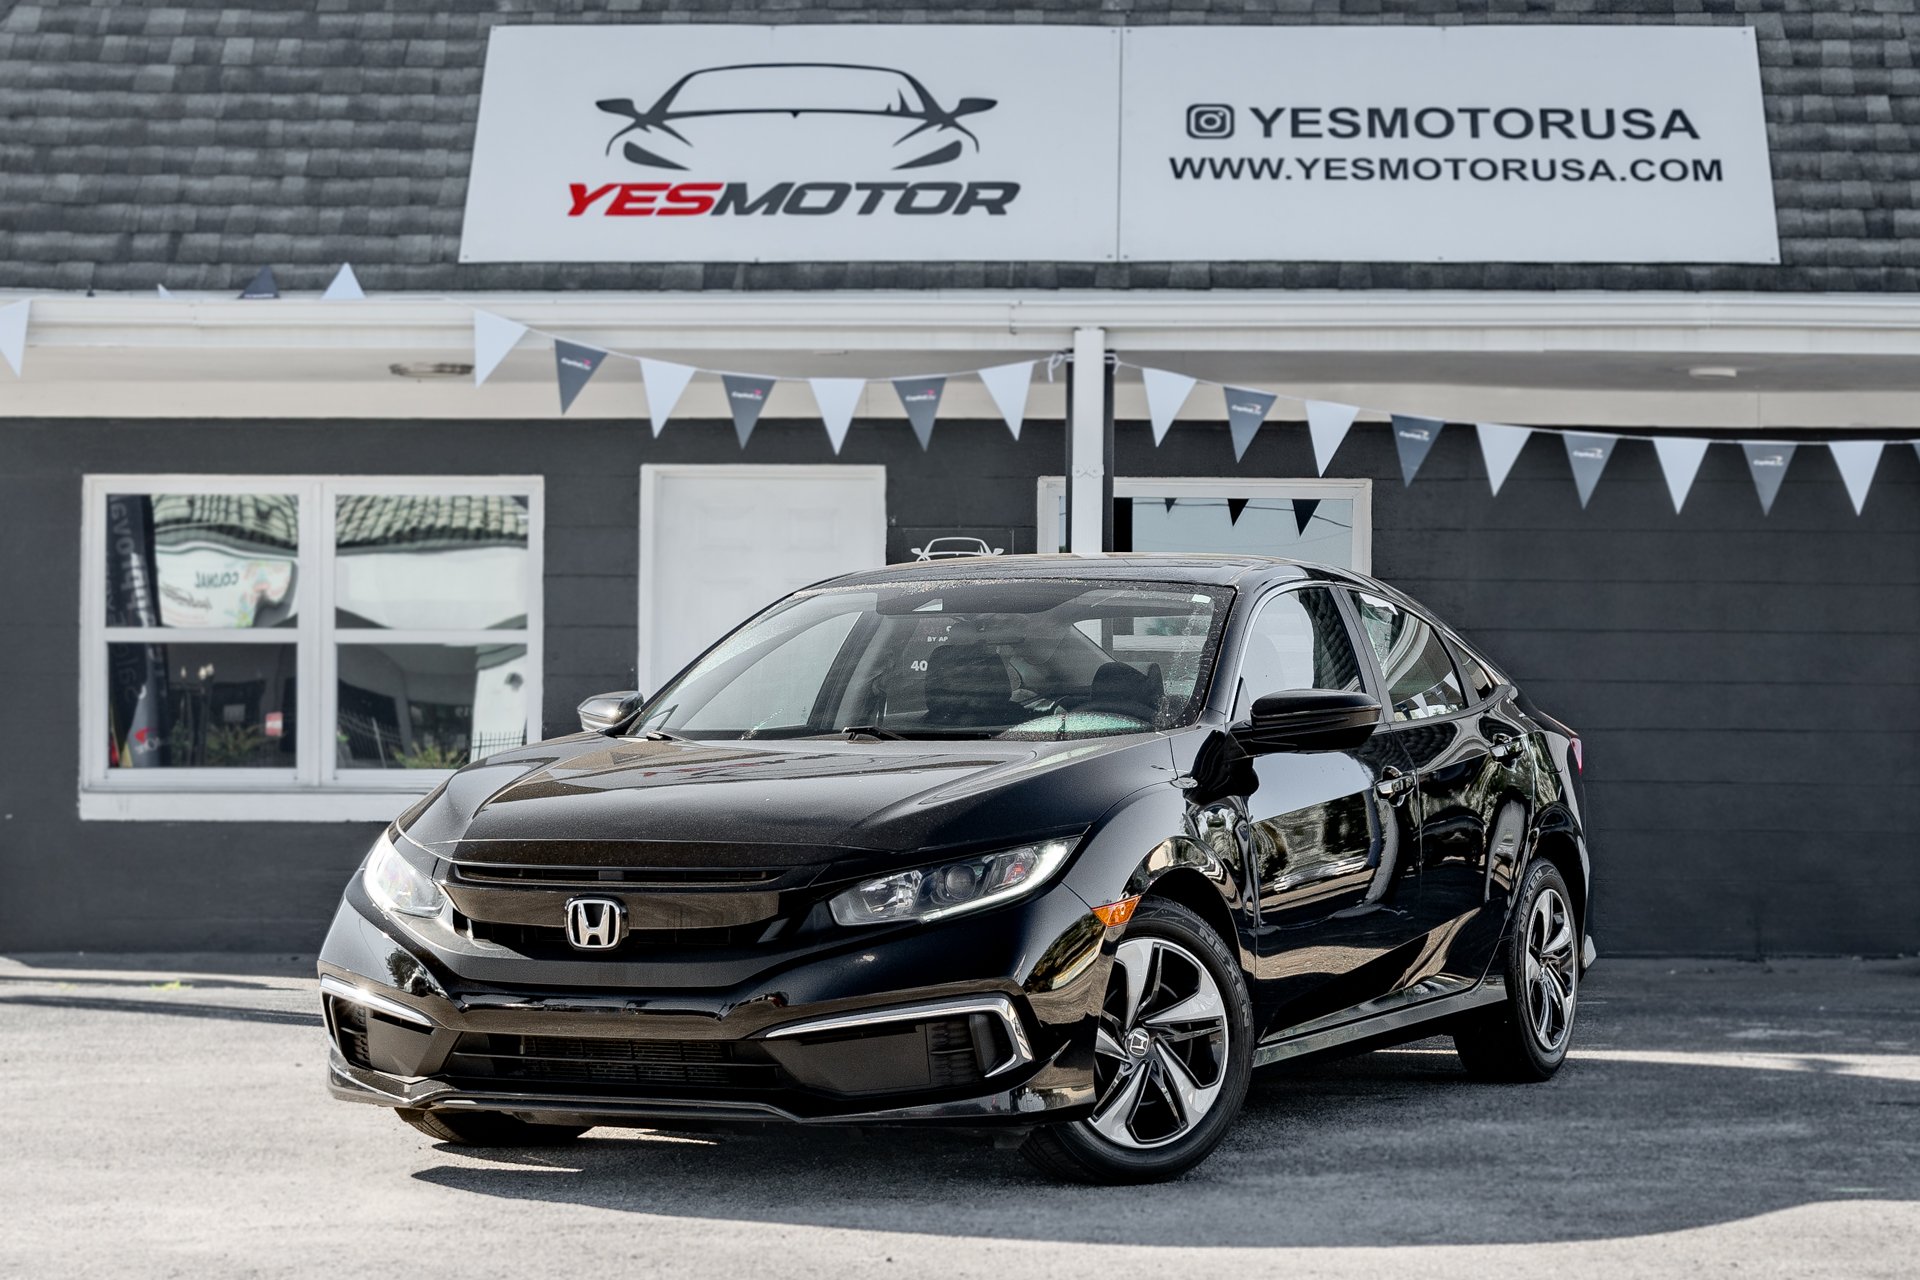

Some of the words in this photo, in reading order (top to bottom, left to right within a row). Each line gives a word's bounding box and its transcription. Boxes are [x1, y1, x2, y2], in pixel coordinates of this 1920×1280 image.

[1248, 107, 1701, 140] YESMOTORUSA
[1168, 157, 1724, 182] WWW.YESMOTORUSA.COM
[1520, 869, 1543, 933] NEXEN
[1199, 928, 1250, 1027] NEXEN
